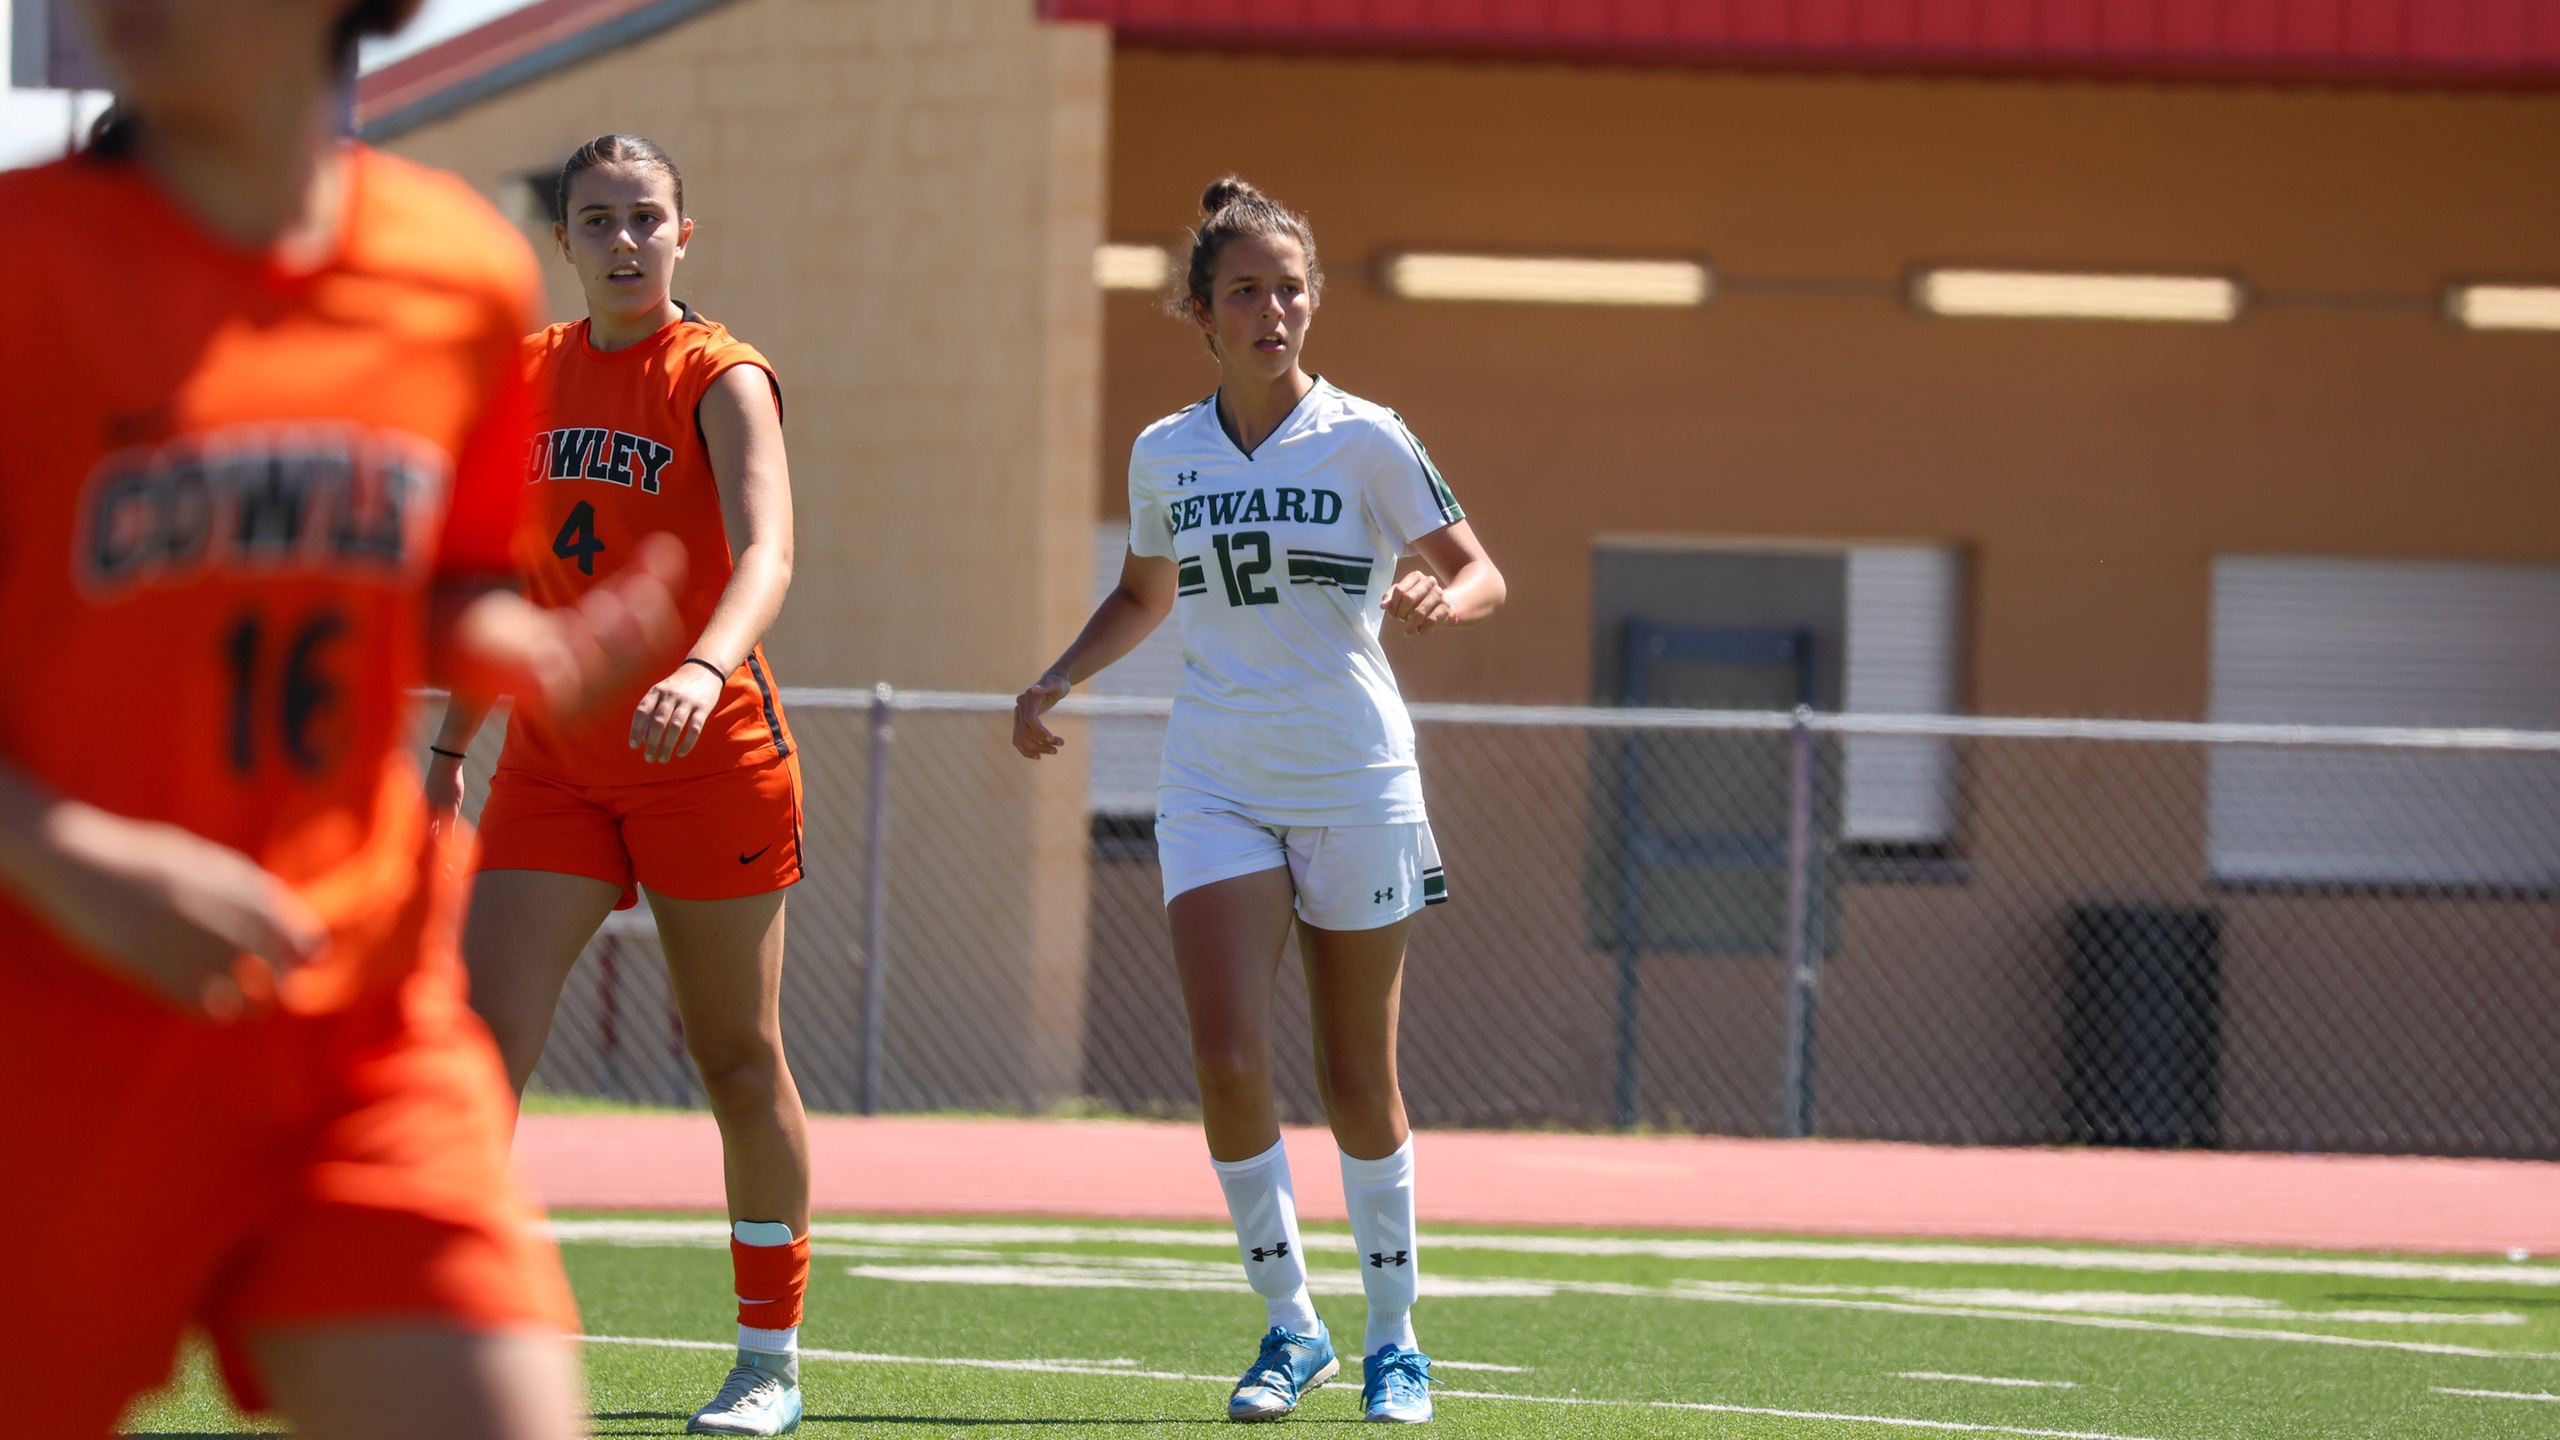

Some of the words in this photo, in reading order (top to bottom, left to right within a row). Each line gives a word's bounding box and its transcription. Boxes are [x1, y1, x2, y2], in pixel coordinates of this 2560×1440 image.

[525, 427, 673, 495] OWLEY
[552, 500, 606, 577] 4
[1170, 486, 1343, 535] SEWARD
[1212, 530, 1279, 607] 12
[221, 604, 356, 784] 16
